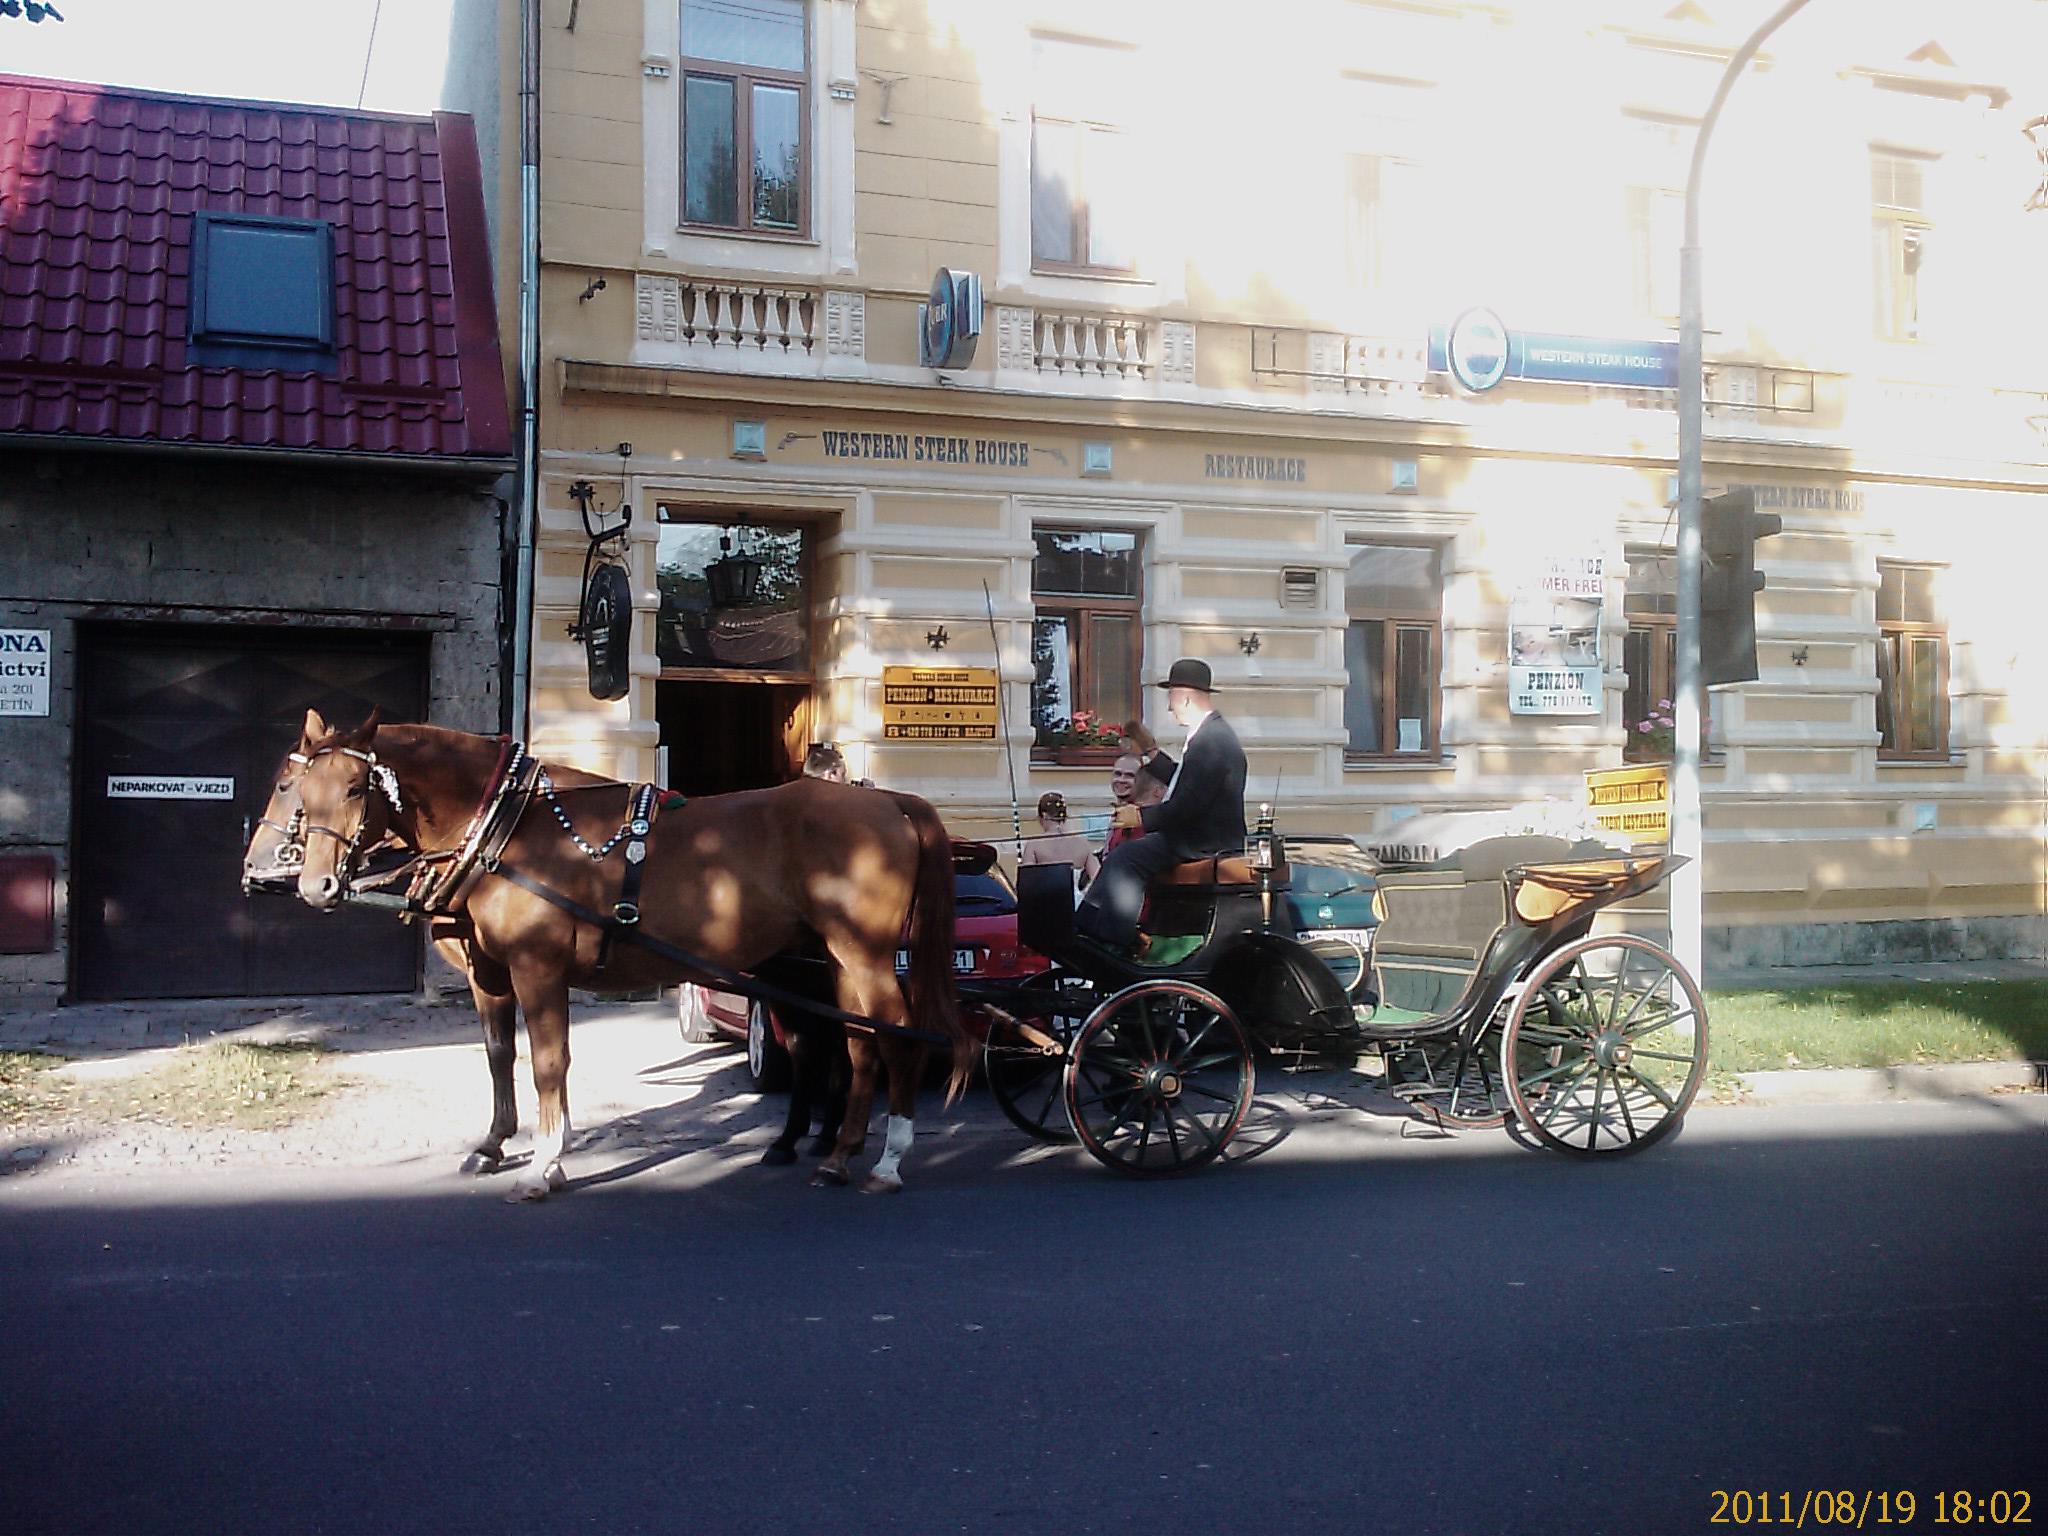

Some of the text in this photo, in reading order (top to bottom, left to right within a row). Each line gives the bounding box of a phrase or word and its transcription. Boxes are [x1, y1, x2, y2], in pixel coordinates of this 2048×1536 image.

[1530, 349, 1662, 369] WESTERN STEAK HOUSE
[822, 431, 1029, 467] WESTERN STEAK HOUSE
[1205, 454, 1305, 482] RESTAURACE
[1527, 672, 1585, 691] PENZION
[887, 688, 927, 702] PENZION
[934, 688, 994, 703] RESTAURACE
[111, 781, 186, 793] NEPARKOVAT
[194, 783, 230, 793] VJEZD
